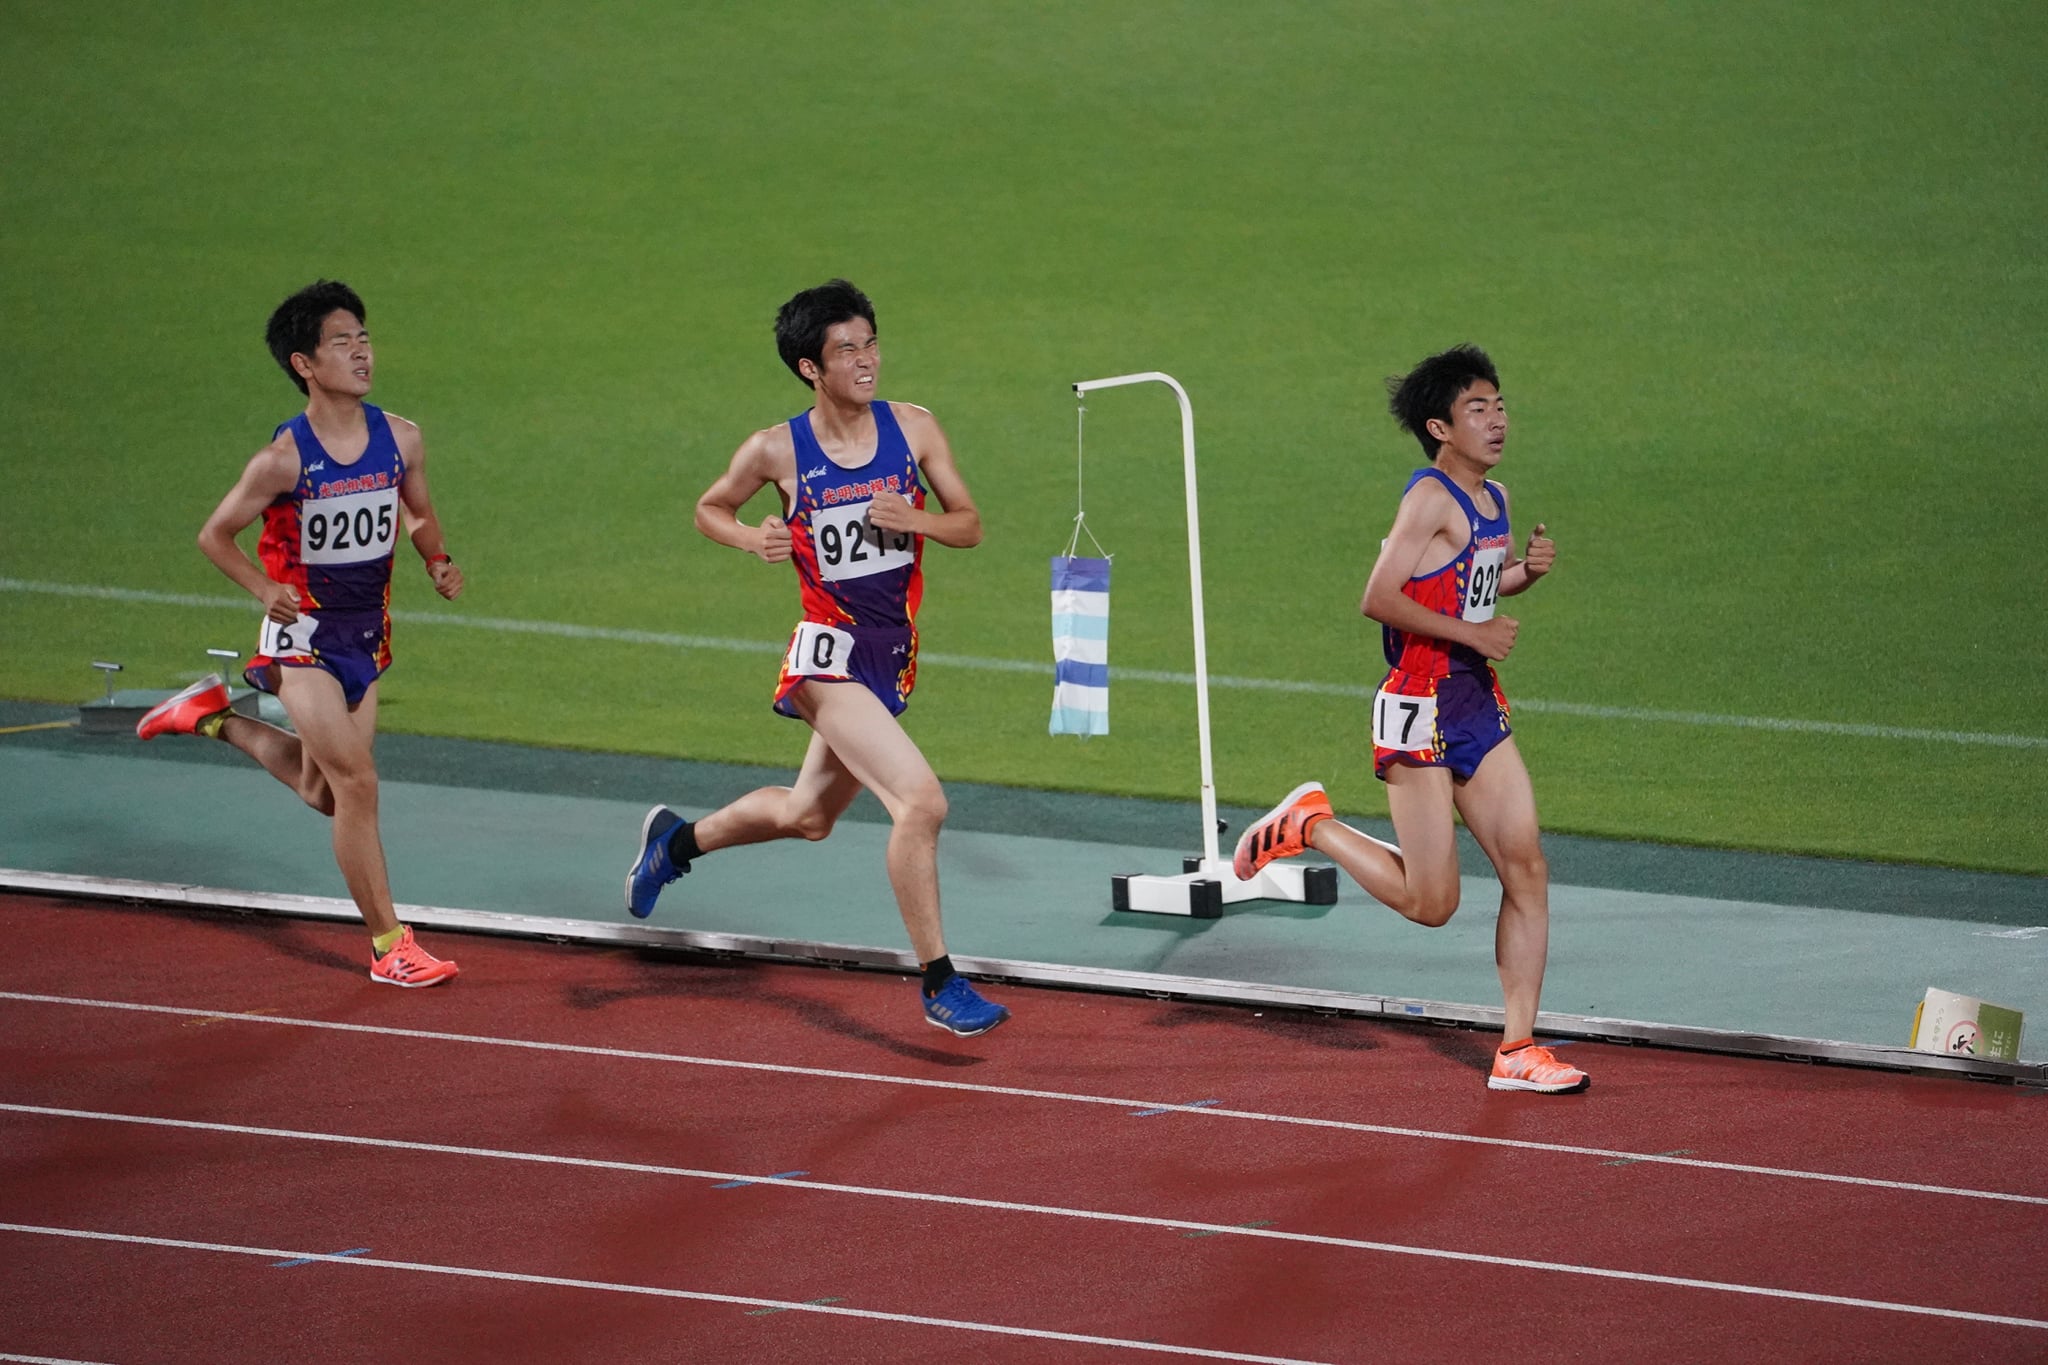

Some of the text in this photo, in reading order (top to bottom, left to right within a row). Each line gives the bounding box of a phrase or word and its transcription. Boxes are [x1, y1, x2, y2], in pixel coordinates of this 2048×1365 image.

[822, 475, 901, 504] 光明相模原
[308, 504, 392, 551] 9205
